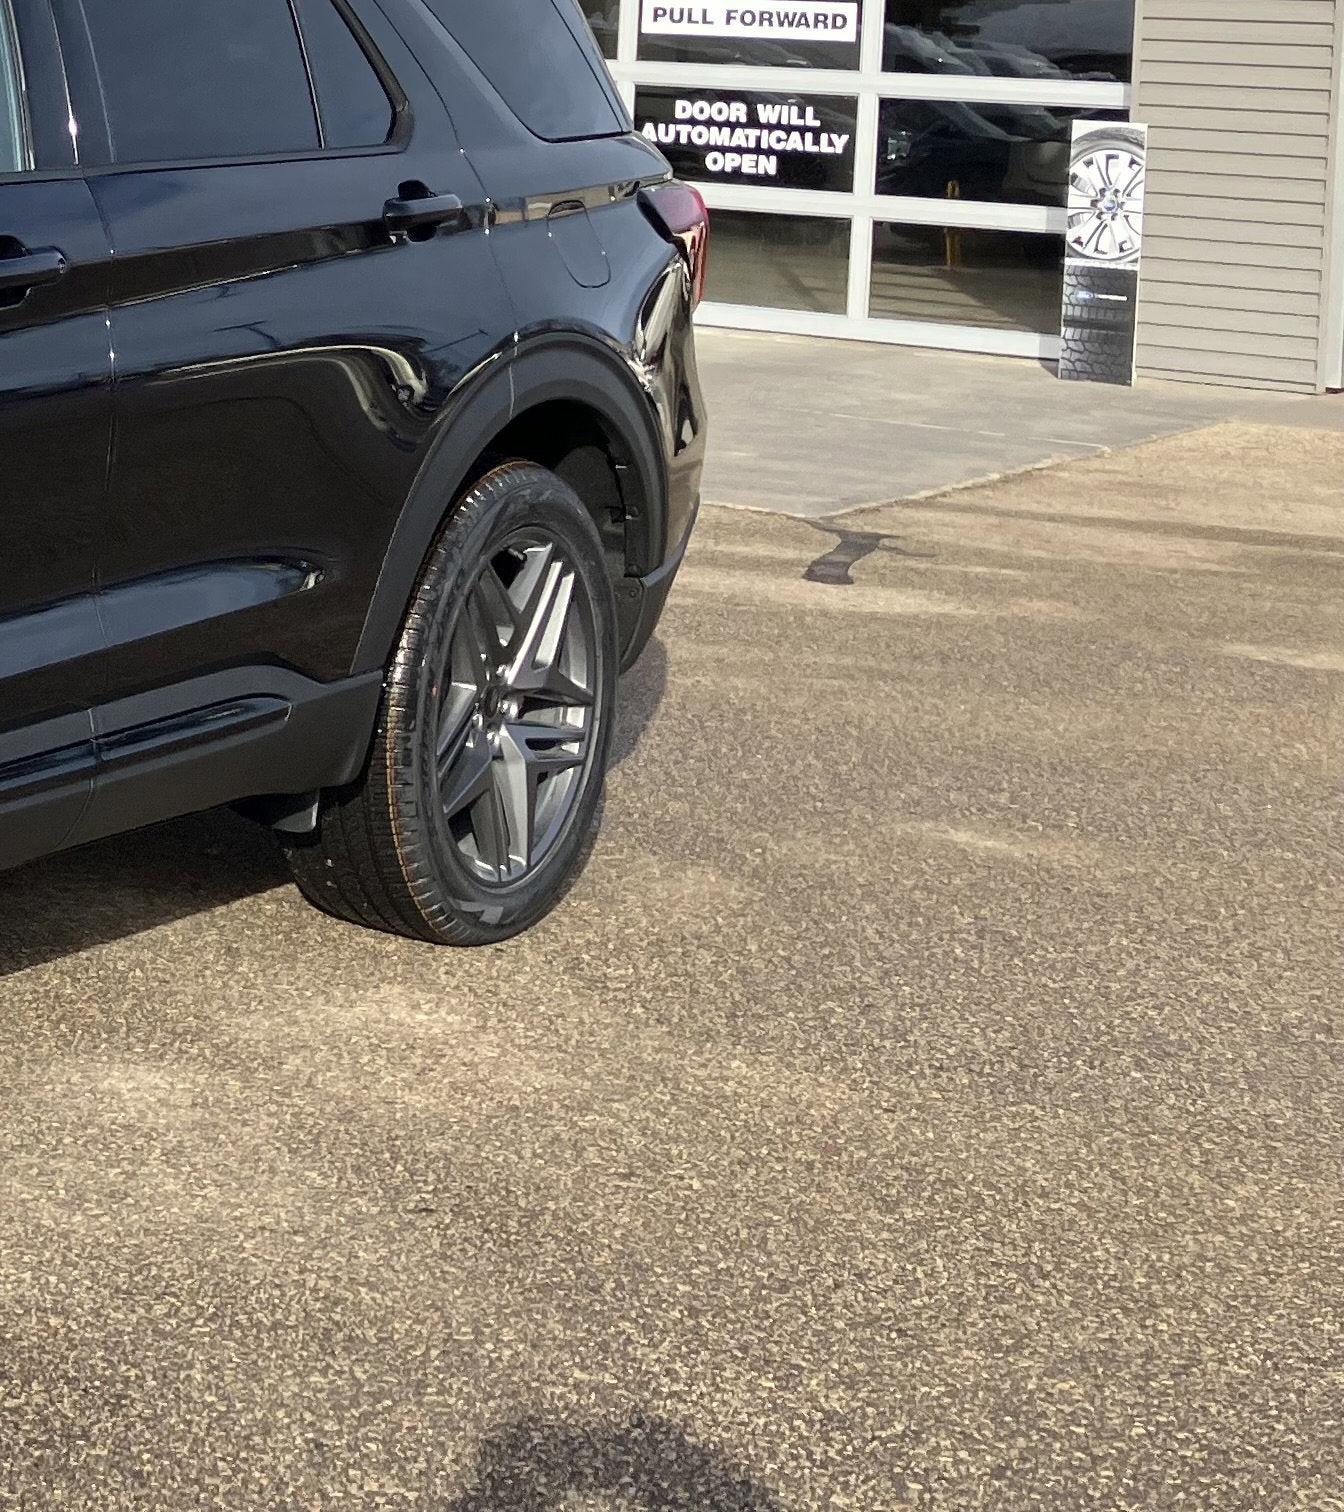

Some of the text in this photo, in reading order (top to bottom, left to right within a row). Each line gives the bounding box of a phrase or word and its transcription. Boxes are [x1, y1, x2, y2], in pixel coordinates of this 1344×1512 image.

[653, 6, 848, 30] PULL FORWARD
[675, 99, 821, 127] DOOR WILL
[642, 122, 849, 154] AUTOMATICALLY
[705, 151, 777, 175] OPEN
